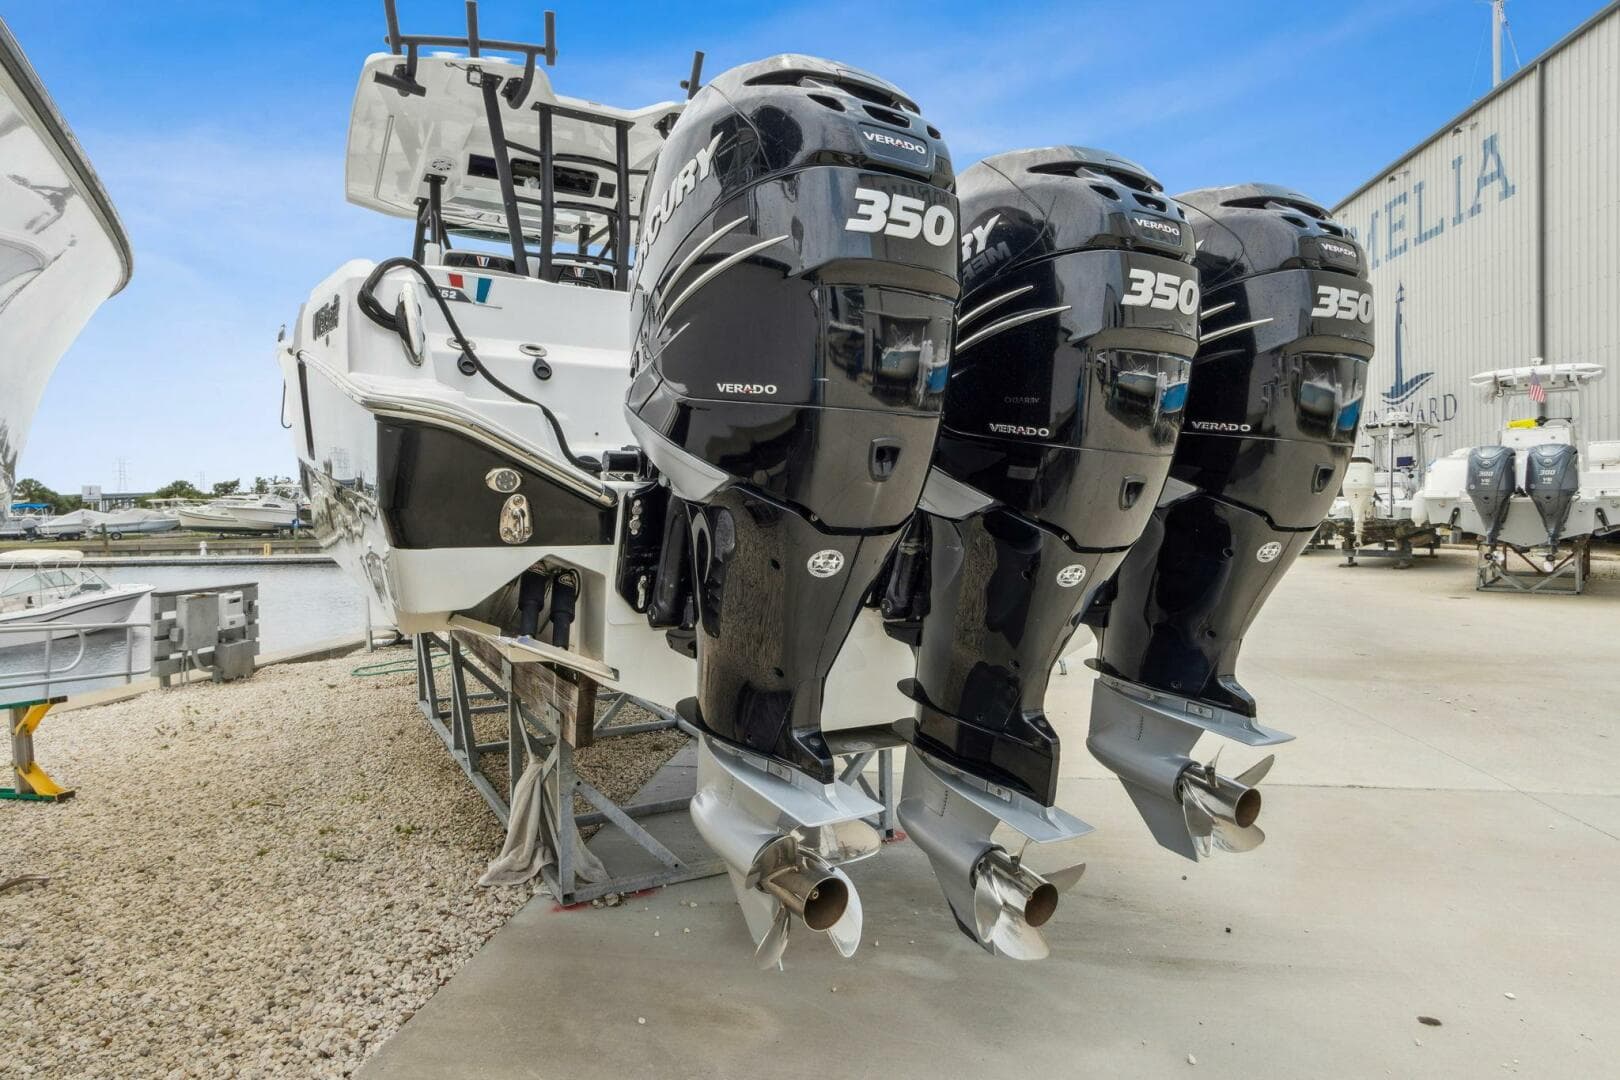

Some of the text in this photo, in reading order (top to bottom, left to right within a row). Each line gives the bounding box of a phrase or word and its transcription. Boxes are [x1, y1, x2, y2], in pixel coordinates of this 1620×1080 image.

[863, 131, 926, 155] VERADO
[845, 187, 955, 247] 350
[1134, 216, 1180, 236] VERADO
[1320, 242, 1357, 259] VERADO
[438, 287, 457, 299] 52
[1121, 268, 1200, 316] 350
[1311, 285, 1373, 324] 350
[716, 382, 778, 395] VERADO
[989, 422, 1050, 438] VERADO
[1191, 421, 1252, 432] VERADO
